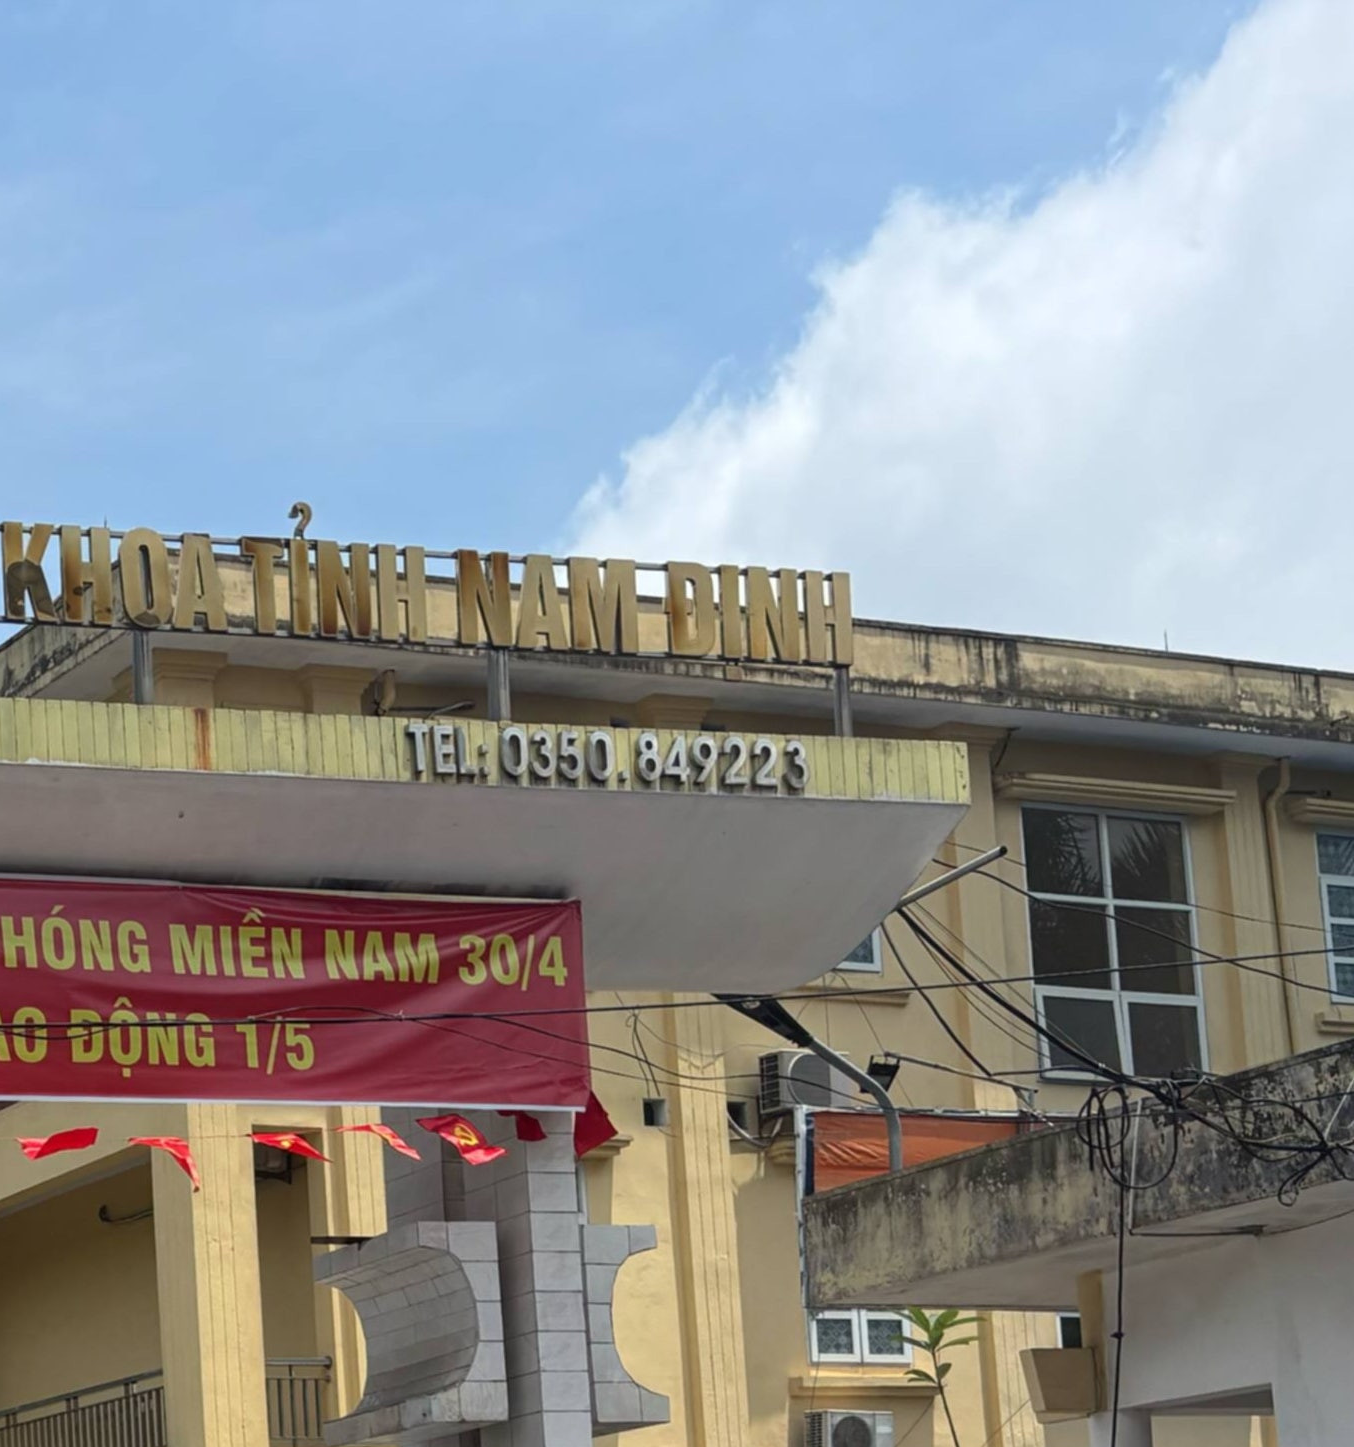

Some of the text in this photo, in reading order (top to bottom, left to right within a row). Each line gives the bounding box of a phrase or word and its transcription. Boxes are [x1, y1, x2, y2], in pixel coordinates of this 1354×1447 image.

[1, 521, 228, 632] KHOA
[241, 501, 428, 644] TỈNH
[455, 549, 639, 653] NAM
[664, 561, 852, 682] ĐỊNH
[406, 723, 490, 777] TEL:
[171, 907, 305, 979] MIỀN
[324, 929, 440, 983] NAM
[458, 933, 568, 991] 30/4
[67, 997, 216, 1078] ĐỘNG
[236, 1021, 315, 1075] 1/5
